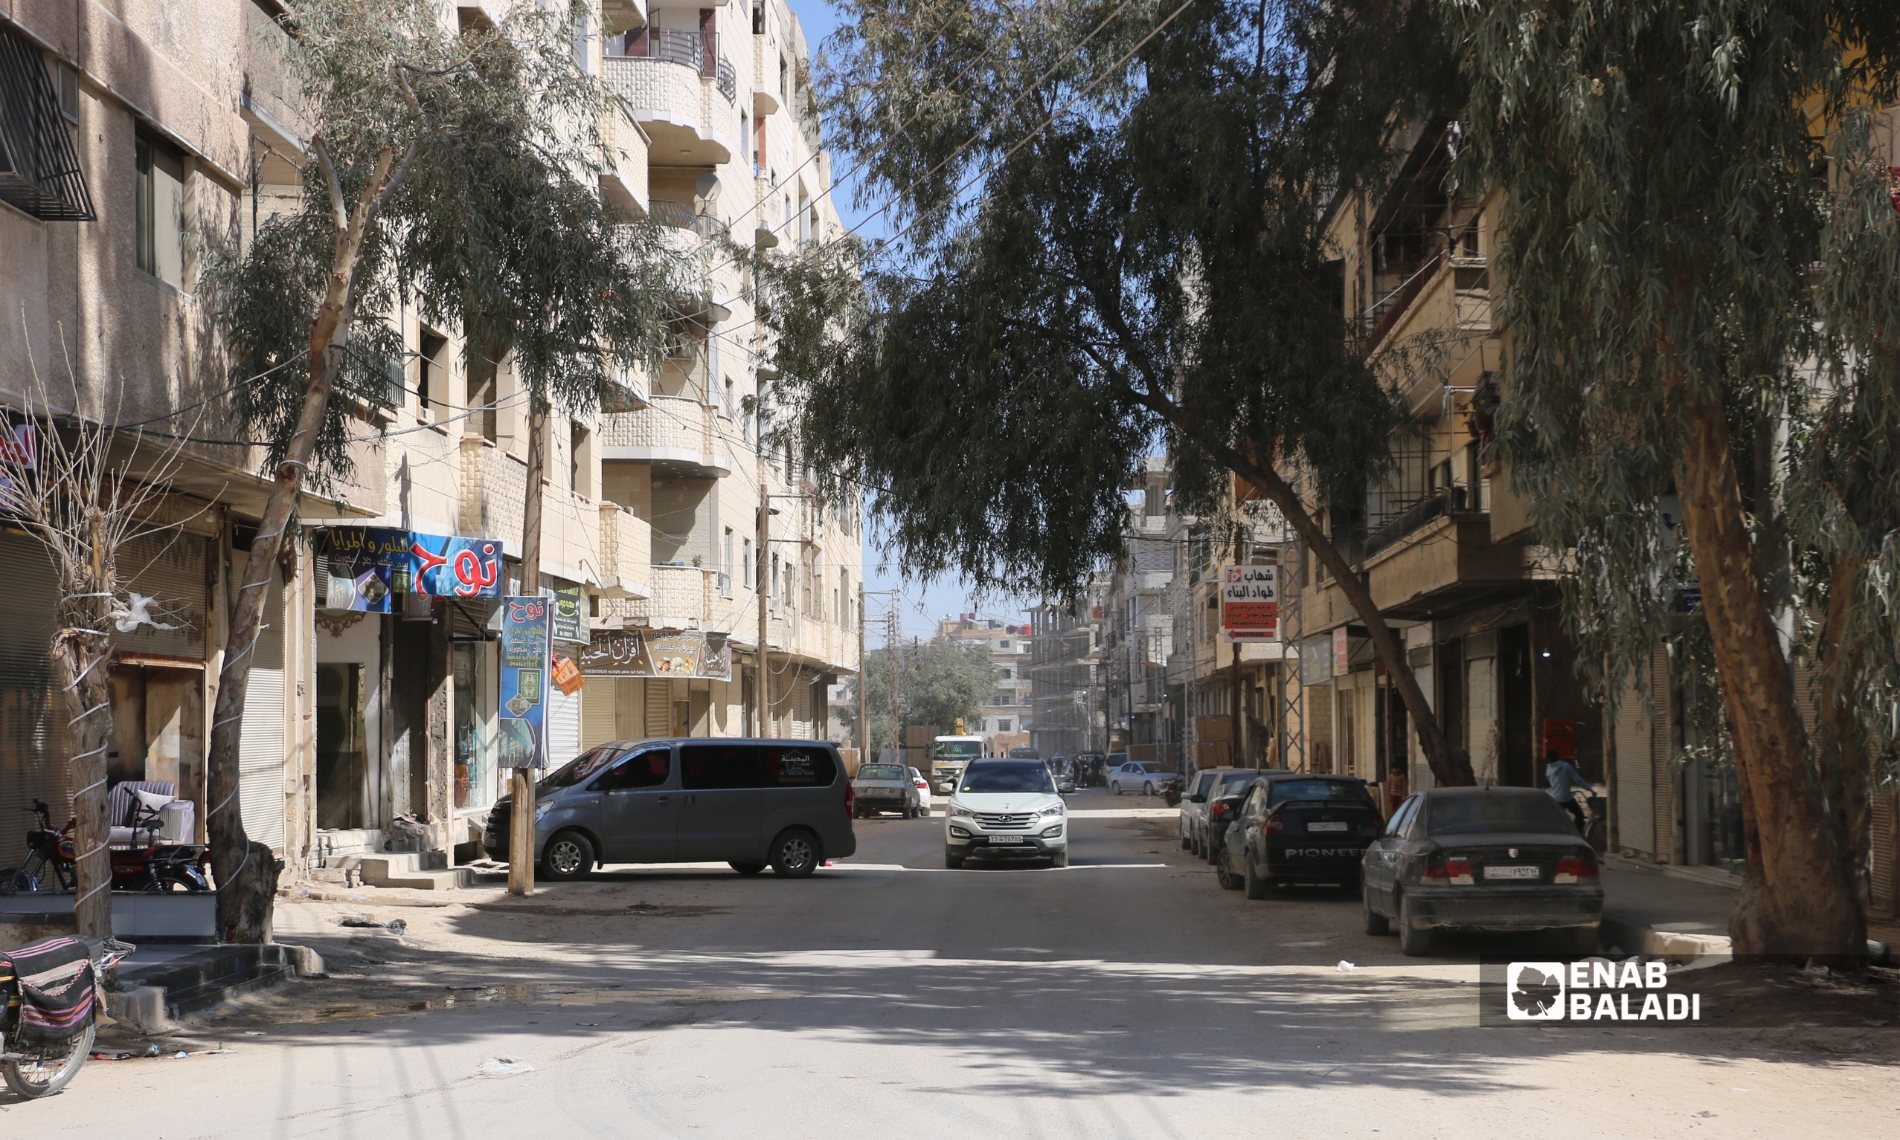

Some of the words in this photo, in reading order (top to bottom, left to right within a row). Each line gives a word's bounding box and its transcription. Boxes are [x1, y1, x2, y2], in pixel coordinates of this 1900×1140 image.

[331, 530, 365, 551] المرايا
[409, 541, 497, 601] نوح
[1244, 569, 1273, 584] شهاب
[1227, 585, 1250, 600] البناء
[509, 601, 544, 623] نوح
[781, 754, 810, 763] المدينة
